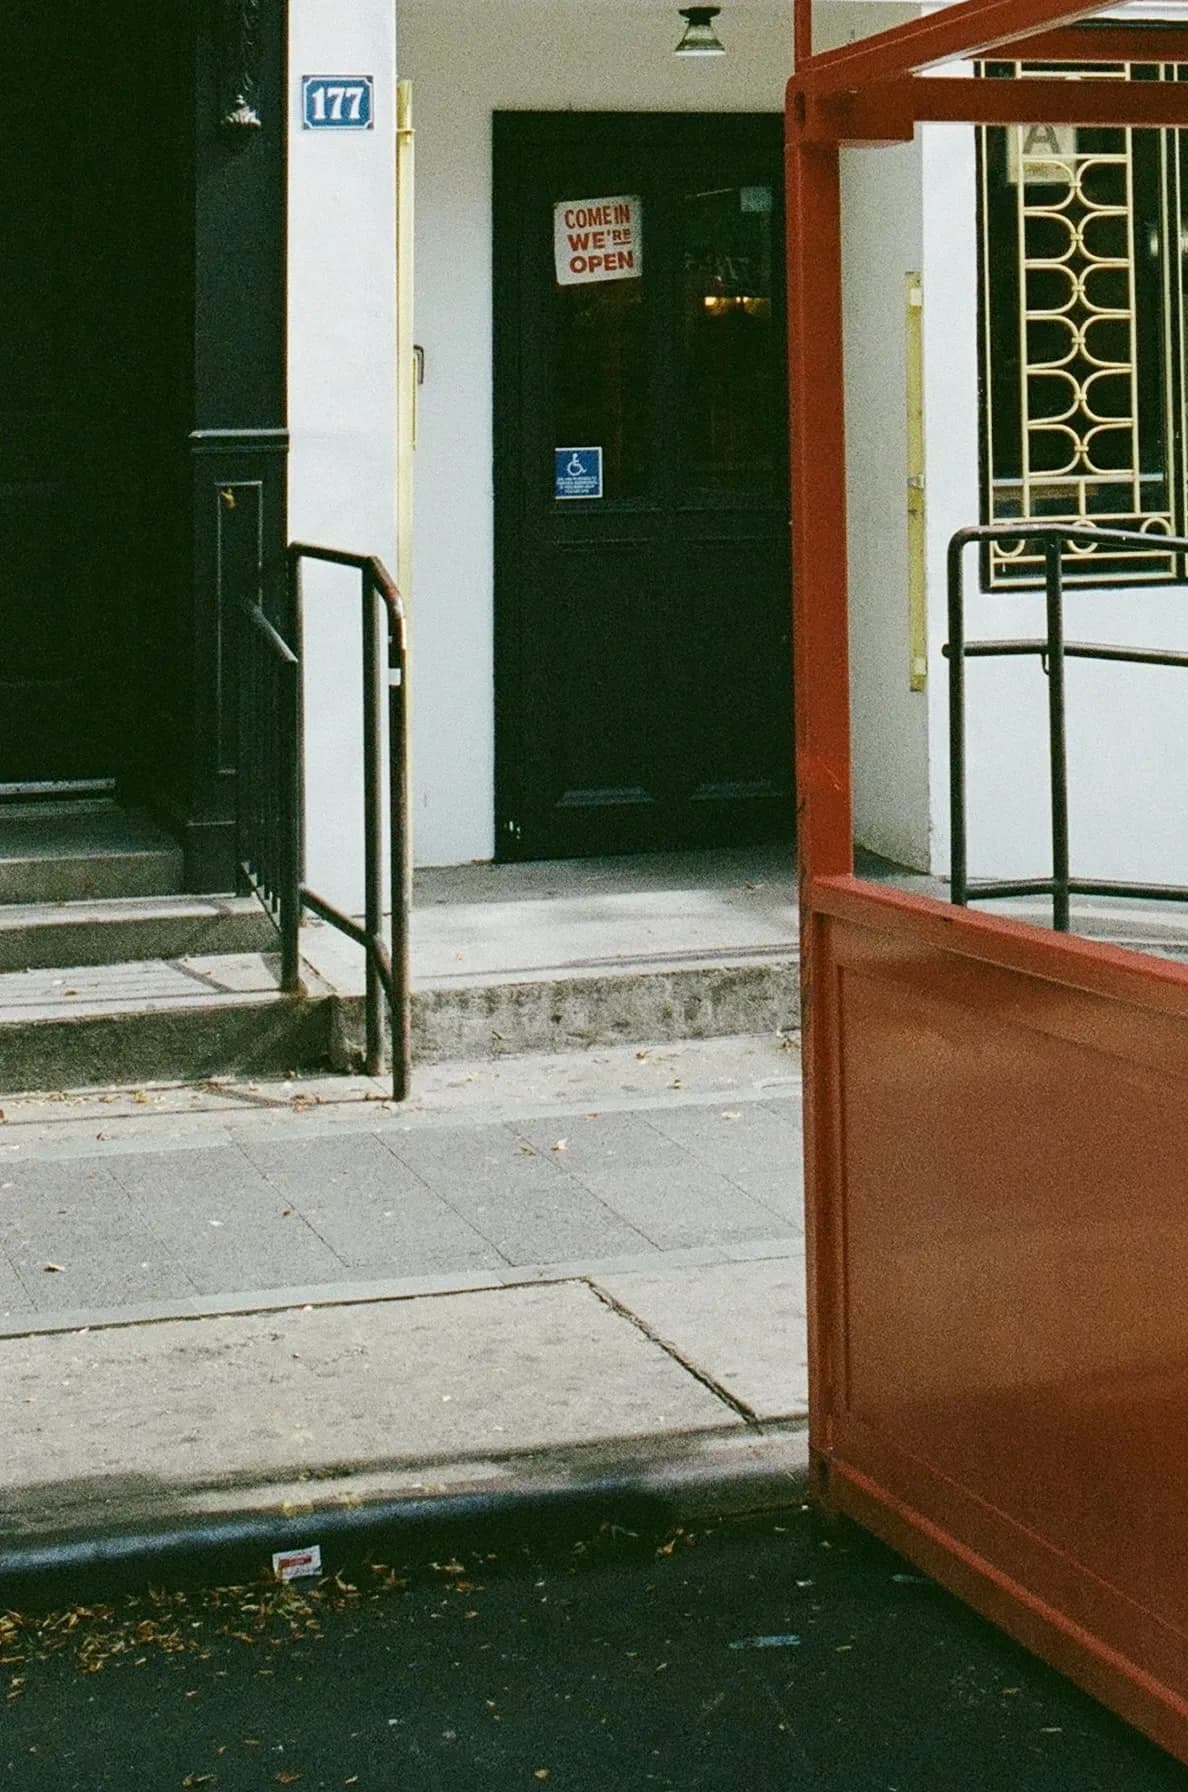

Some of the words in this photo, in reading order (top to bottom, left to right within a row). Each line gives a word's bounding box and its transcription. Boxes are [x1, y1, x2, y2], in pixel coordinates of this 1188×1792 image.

[312, 87, 364, 119] 177
[1022, 125, 1061, 154] A
[564, 207, 612, 229] COME
[614, 204, 631, 224] IN
[567, 228, 632, 251] WE'RE
[569, 250, 635, 274] OPEN
